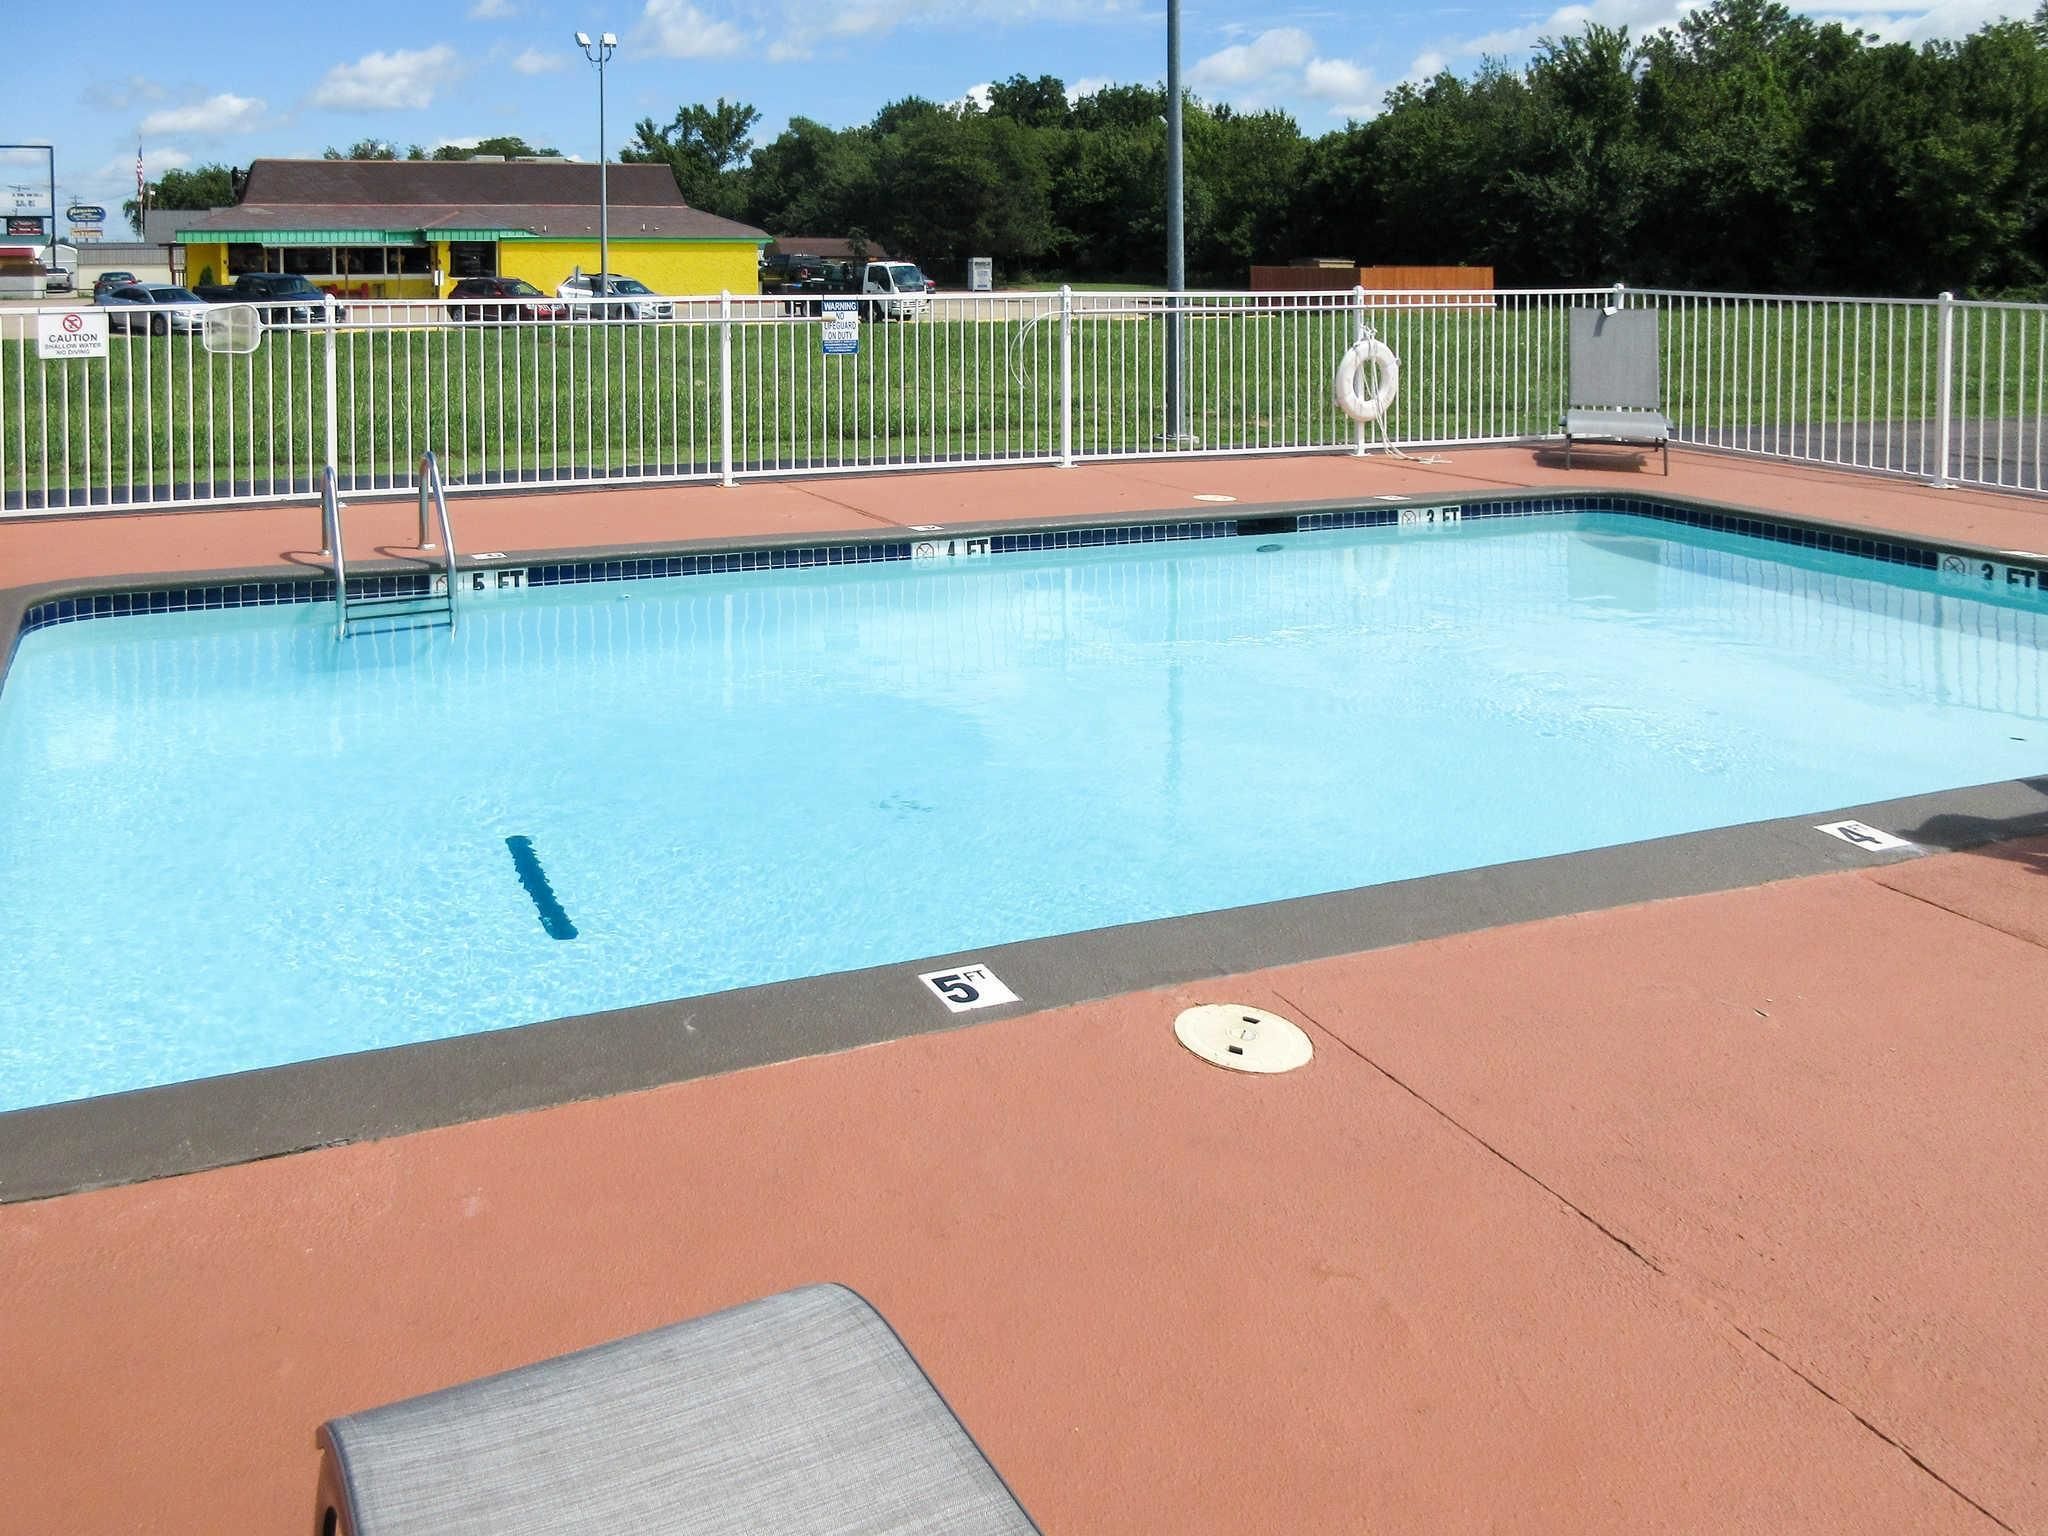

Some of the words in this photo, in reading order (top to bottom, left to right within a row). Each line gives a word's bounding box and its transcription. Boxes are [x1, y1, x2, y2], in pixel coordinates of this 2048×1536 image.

[823, 301, 857, 311] WARNING
[835, 311, 845, 320] NO
[824, 321, 857, 330] LIFEGUARD
[48, 333, 98, 343] CAUTION
[828, 331, 837, 340] ON
[838, 331, 853, 340] DUTY
[1442, 506, 1460, 522] FT
[946, 540, 956, 557] 4
[966, 538, 990, 556] FT
[472, 572, 486, 591] 5
[497, 568, 525, 590] FT
[2006, 566, 2036, 588] FT
[1837, 826, 1883, 845] 4
[931, 974, 980, 1003] 5
[962, 969, 987, 983] FT
